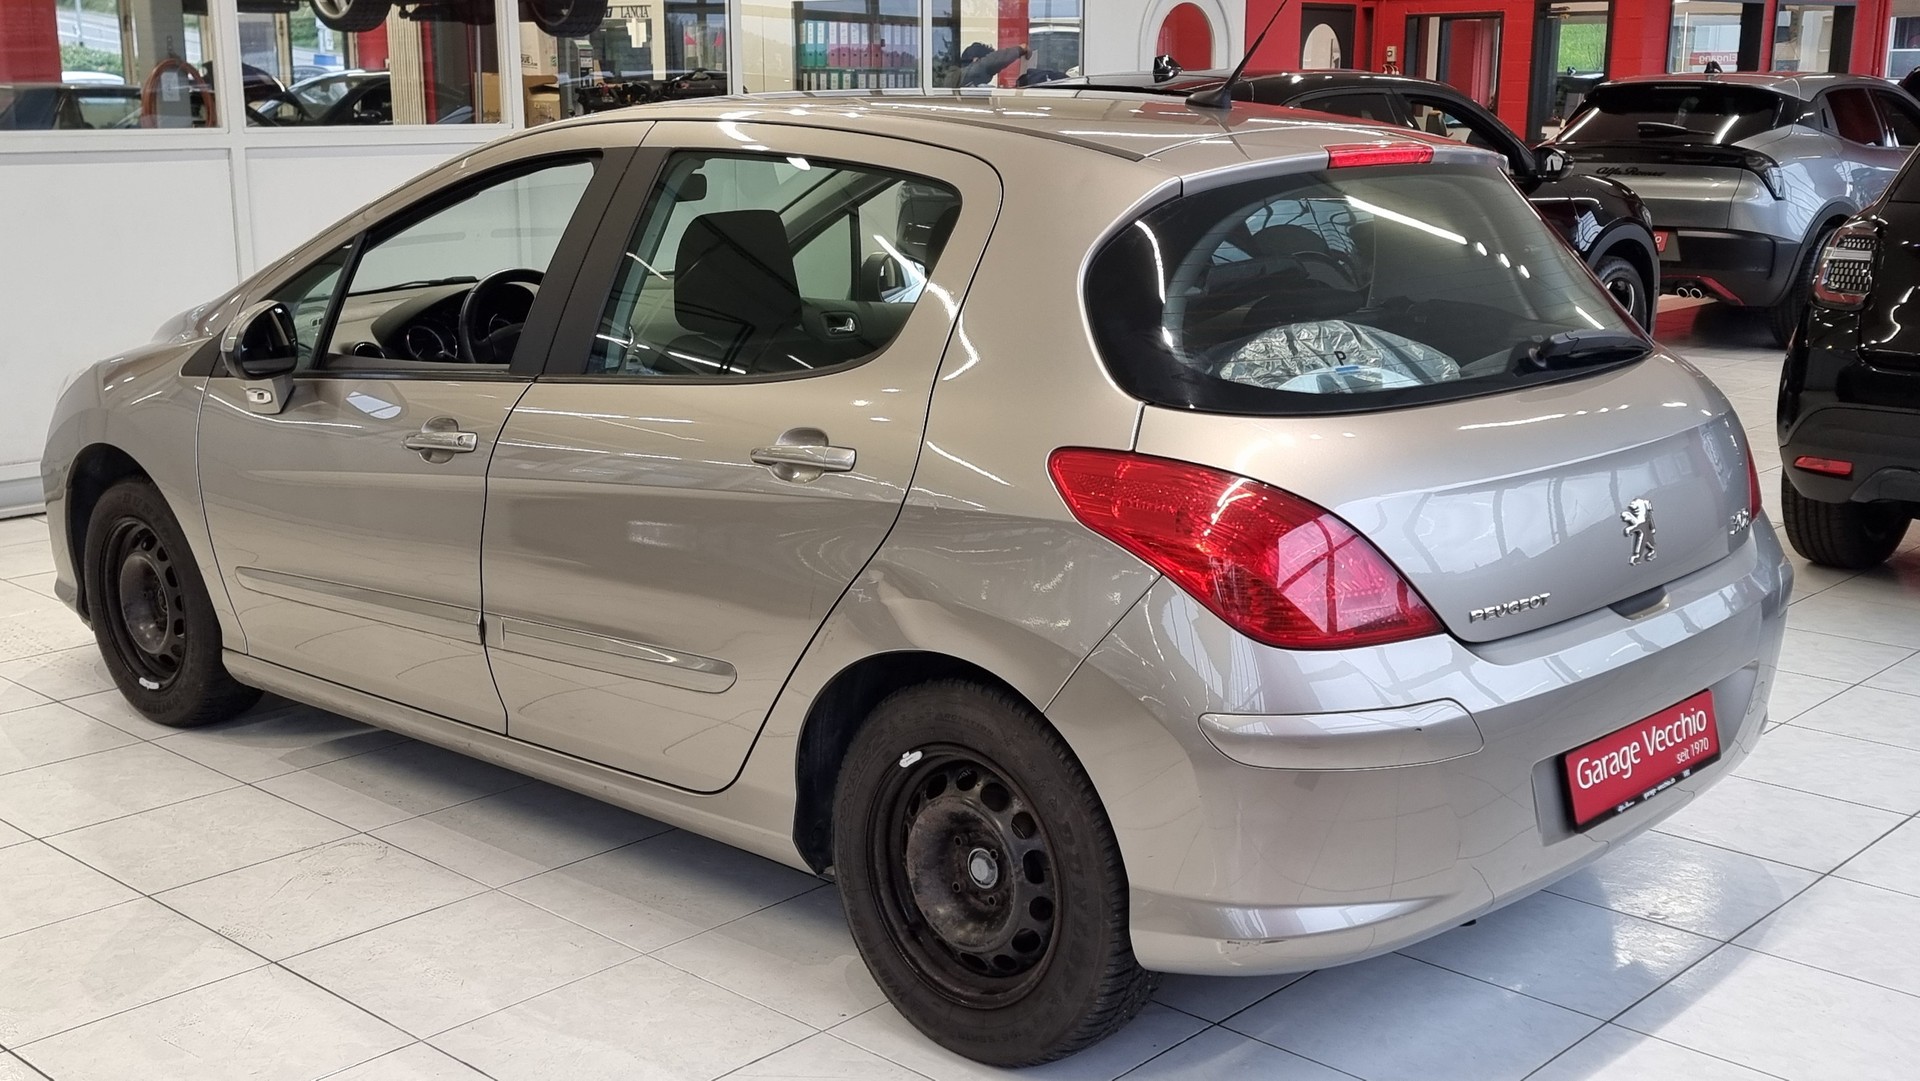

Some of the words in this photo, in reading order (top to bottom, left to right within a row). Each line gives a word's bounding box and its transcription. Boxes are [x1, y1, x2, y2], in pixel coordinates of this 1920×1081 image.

[620, 6, 649, 18] LANCIA
[1596, 167, 1622, 177] Alfa
[1334, 351, 1346, 366] P
[1469, 592, 1551, 624] PEUGEOT
[1577, 741, 1641, 789] Garage
[1642, 708, 1707, 756] Vecchio
[1676, 747, 1690, 764] seit
[1690, 737, 1709, 757] 1970
